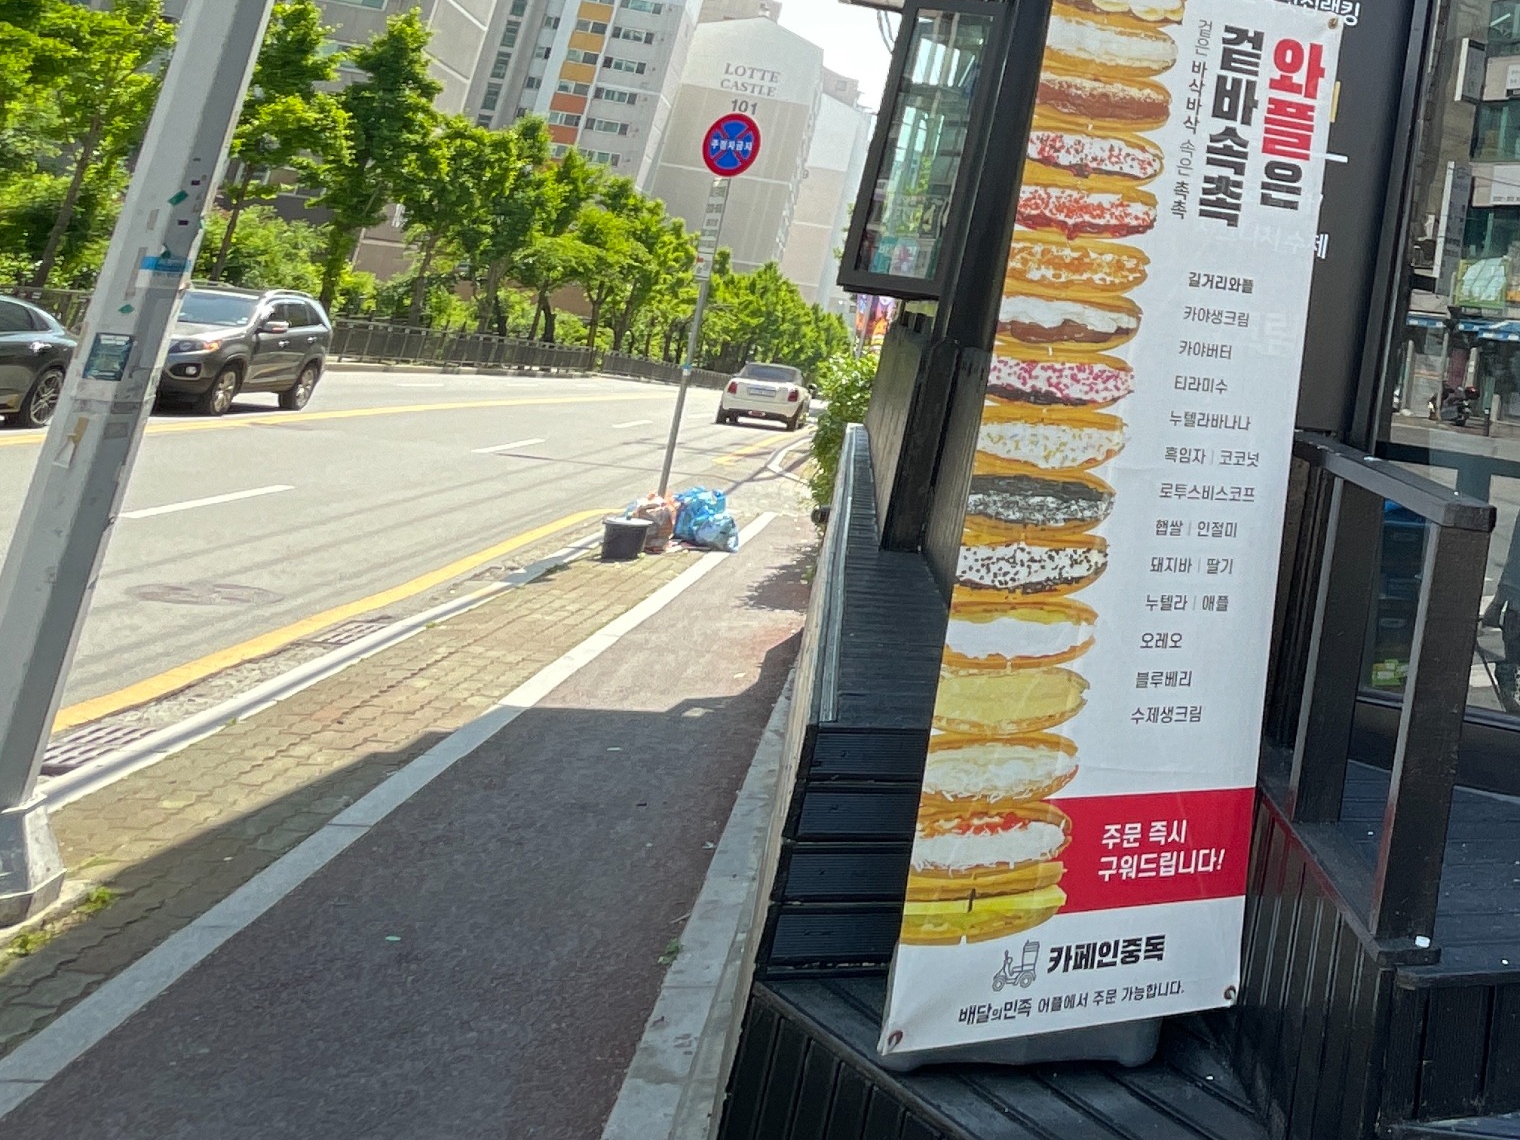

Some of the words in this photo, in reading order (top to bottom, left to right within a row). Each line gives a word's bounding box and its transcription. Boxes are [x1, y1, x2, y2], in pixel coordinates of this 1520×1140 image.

[724, 63, 782, 83] LOTTE
[720, 78, 777, 97] CASTLE
[731, 99, 758, 116] 101
[1199, 24, 1265, 228] 겉바속촉
[1183, 305, 1250, 328] 카야생크림
[1178, 340, 1233, 360] 카야버터
[1174, 375, 1229, 395] 티라미수
[1169, 410, 1252, 431] 누텔라바나나
[1164, 446, 1206, 465] 흑임자
[1219, 449, 1260, 468] 코코넛
[1158, 482, 1256, 503] 로투스비스코프
[1197, 520, 1238, 538] 인절미
[1150, 556, 1193, 575] 돼지바
[1206, 557, 1234, 575] 딸기
[1145, 594, 1188, 611] 누텔라
[1202, 594, 1229, 612] 애플
[1140, 632, 1183, 650] 오레오
[1135, 670, 1193, 689] 블루베리
[1130, 705, 1203, 725] 수제생크림
[1102, 822, 1142, 850] 주문
[1148, 819, 1188, 846] 즉시
[1098, 848, 1226, 882] 구워드립니다!
[1046, 934, 1166, 975] 카페인중독
[958, 996, 1033, 1026] 배달의민족
[1037, 992, 1089, 1014] 어플에서
[1093, 988, 1117, 1007] 주문
[1121, 980, 1186, 1004] 가능합니다.
